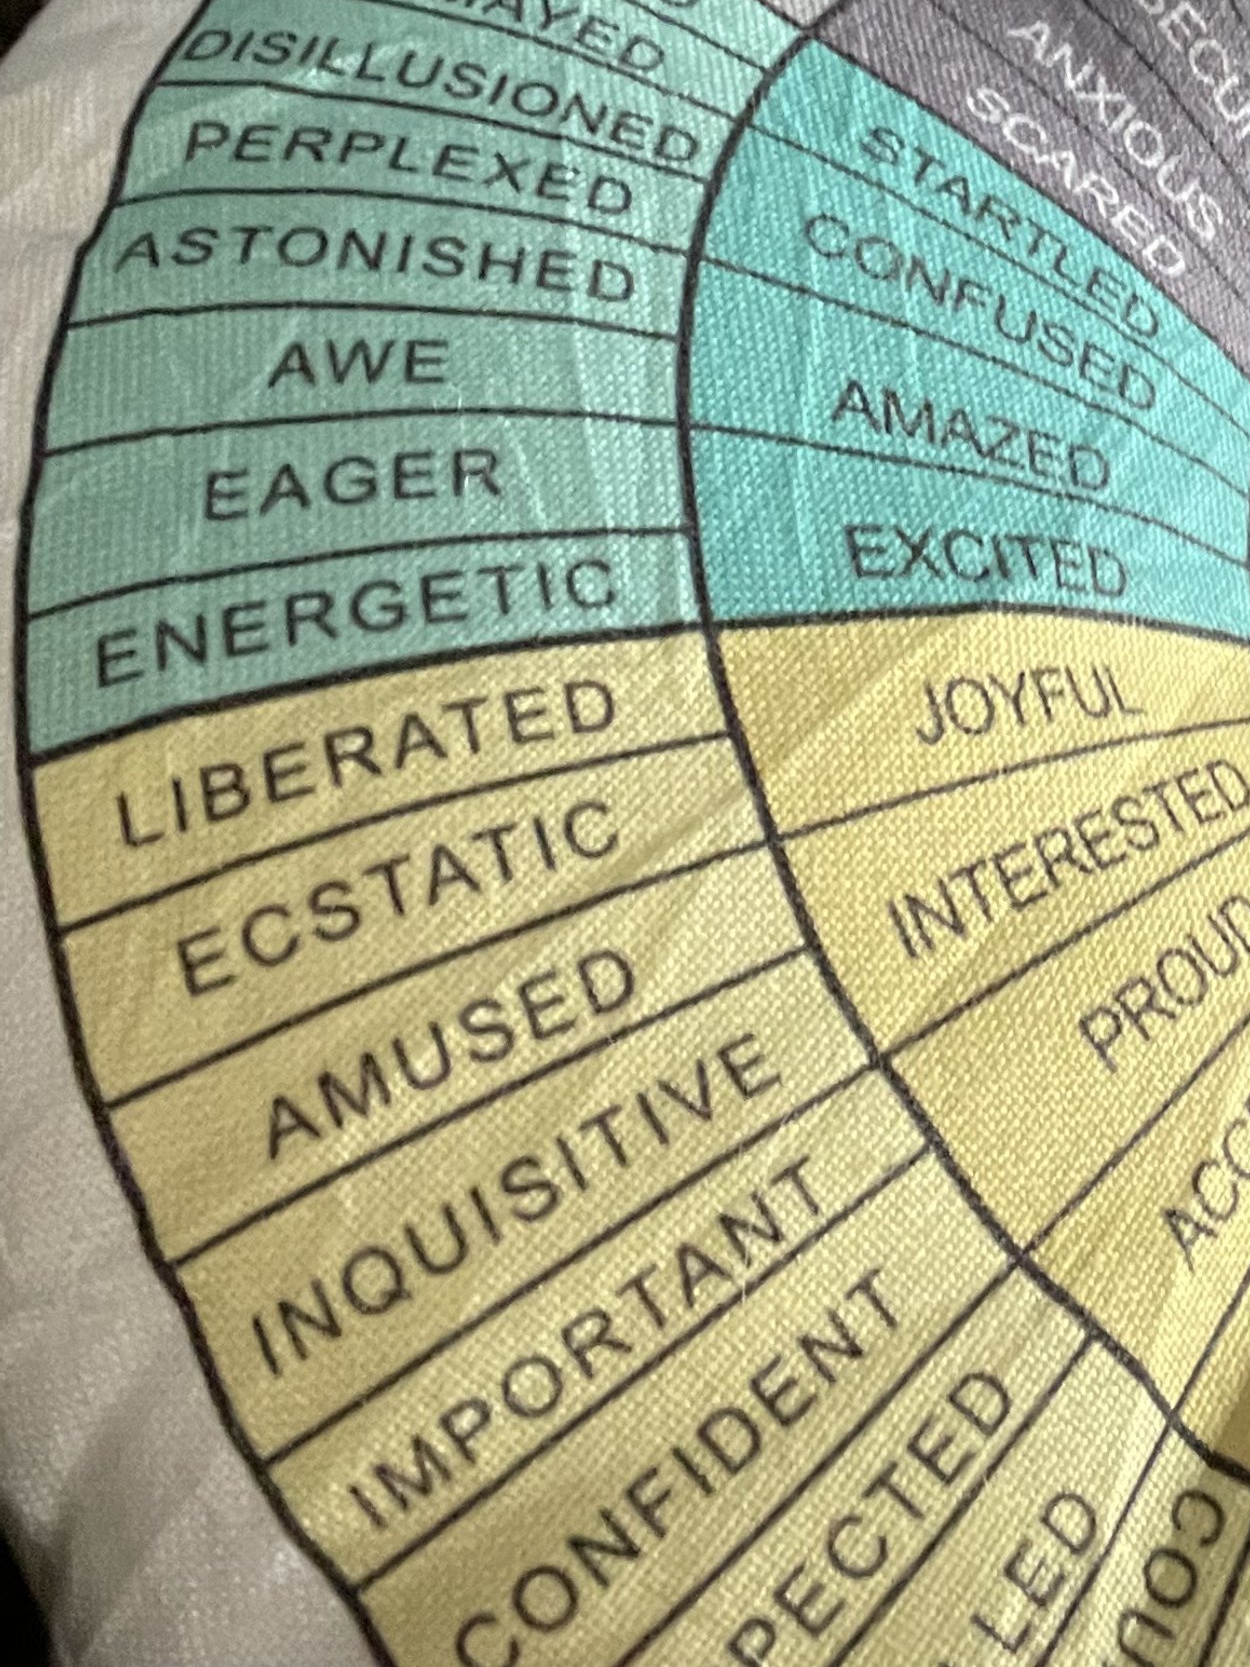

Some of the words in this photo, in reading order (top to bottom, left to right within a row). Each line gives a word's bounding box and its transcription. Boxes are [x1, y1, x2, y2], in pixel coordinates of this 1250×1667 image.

[182, 29, 698, 166] DISILLUSIONED
[183, 121, 634, 216] PERPLEXED
[966, 86, 1186, 277] SCARED
[1006, 19, 1224, 243] ANXIOUS
[114, 226, 636, 304] ASTONISHED
[804, 213, 1157, 411] CONFUSED
[861, 125, 1160, 338] STARTLED
[268, 338, 450, 389] AWE
[830, 379, 1111, 493] AMAZED
[204, 448, 501, 521] EAGER
[845, 524, 1129, 599] EXCITED
[95, 559, 615, 689] ENERGETIC
[915, 666, 1145, 745] JOYFUL
[115, 679, 615, 847] LIBERATED
[176, 801, 619, 997] ECSTATIC
[888, 759, 1250, 959] INTERESTED
[265, 949, 636, 1160] AMUSED
[252, 1033, 782, 1378] INQUISITIVE
[349, 1156, 823, 1530] IMPORTANT
[455, 1268, 898, 1667] CONFIDENT
